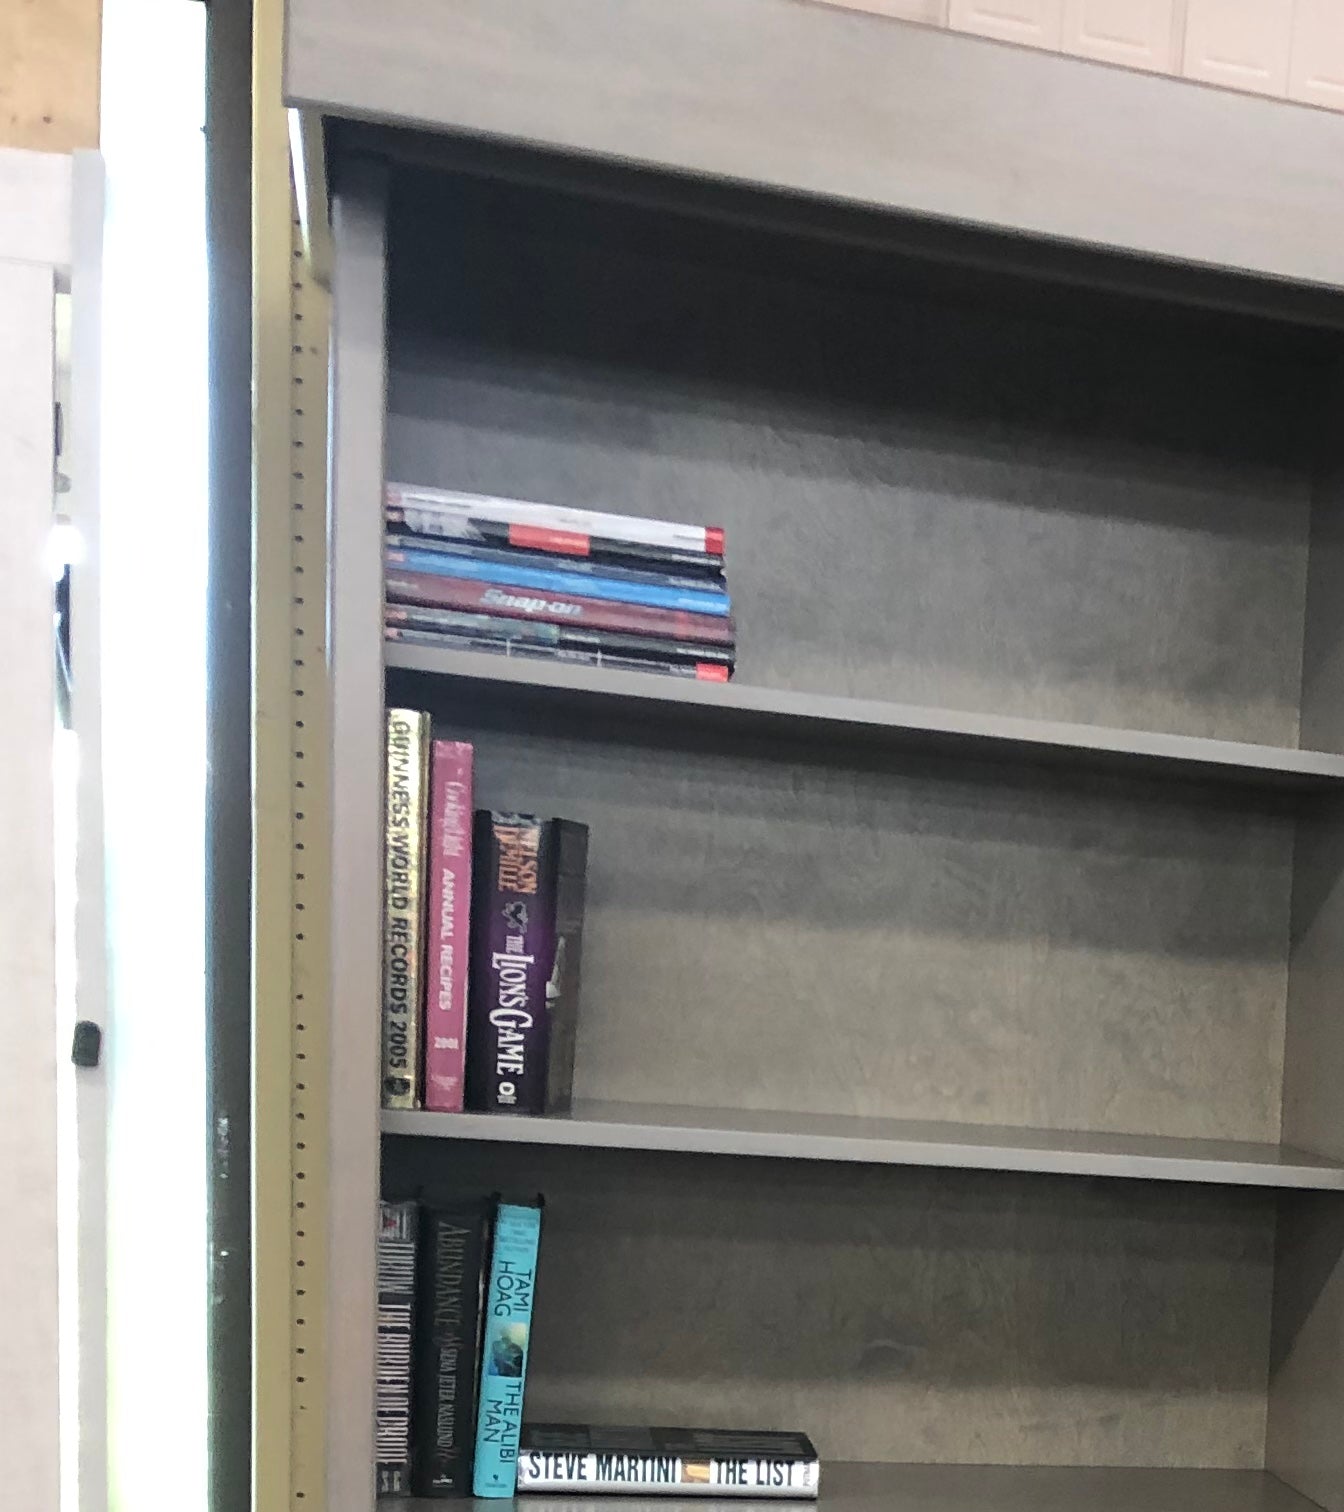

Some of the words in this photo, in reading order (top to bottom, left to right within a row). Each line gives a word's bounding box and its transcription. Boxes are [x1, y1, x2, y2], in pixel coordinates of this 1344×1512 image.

[479, 588, 585, 617] Snap-on
[389, 720, 412, 832] GUINNESS
[389, 833, 411, 911] WORLD
[440, 867, 456, 940] ANNUAL
[388, 917, 410, 1014] RECORDS
[438, 943, 456, 1011] RECIPES
[388, 1020, 408, 1070] 2005
[488, 1008, 534, 1076] GAME
[434, 1222, 471, 1326] ABUNDANCE
[494, 1260, 516, 1317] HOAG
[514, 1269, 532, 1312] TAMI
[377, 1303, 412, 1329] THE
[377, 1332, 410, 1394] BURDEN
[439, 1347, 458, 1372] SENA
[438, 1374, 457, 1401] JETER
[504, 1382, 522, 1416] THE
[436, 1403, 456, 1449] NASLUND
[485, 1399, 503, 1443] MAN
[499, 1419, 517, 1464] ALIBI
[528, 1450, 588, 1481] STEVE
[595, 1454, 677, 1484] MARTINI
[715, 1457, 748, 1485] THE
[755, 1459, 796, 1487] LIST
